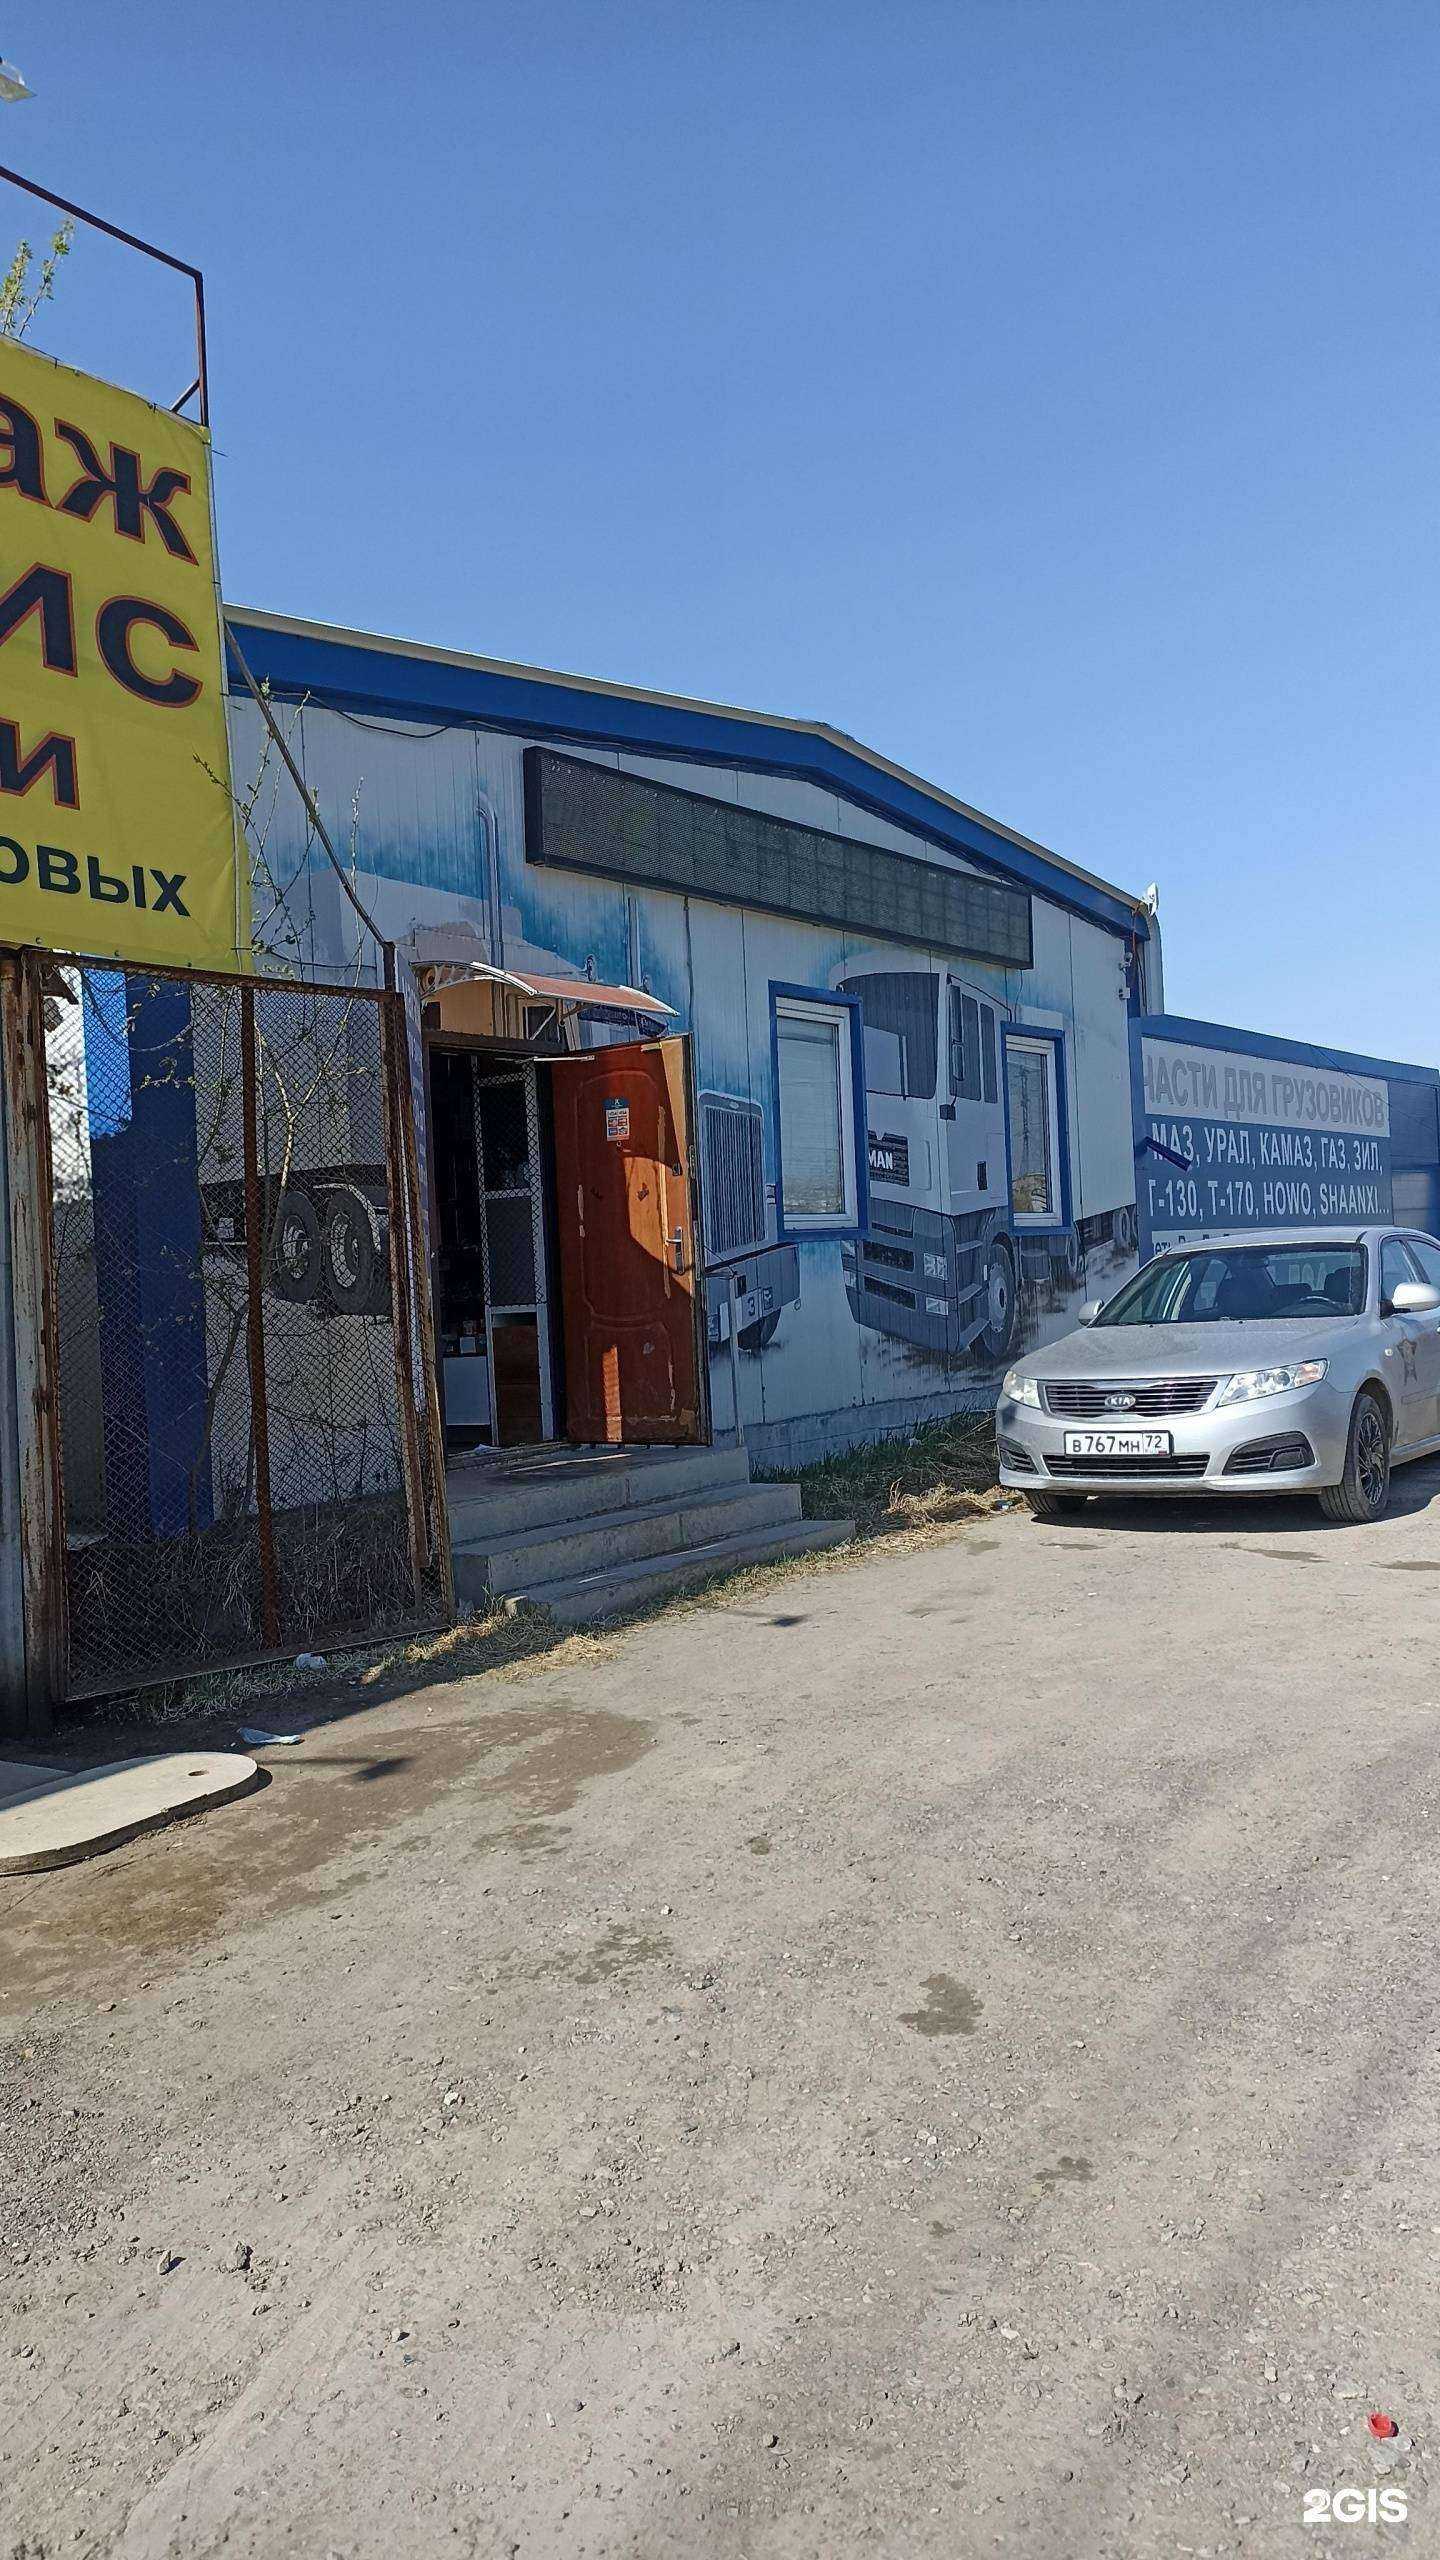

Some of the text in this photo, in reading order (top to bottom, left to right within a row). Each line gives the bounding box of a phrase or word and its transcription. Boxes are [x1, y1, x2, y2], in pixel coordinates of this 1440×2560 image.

[1224, 1067, 1267, 1121] ДЛЯ
[1271, 1074, 1385, 1128] ГРУЗОВИКОВ
[1204, 1127, 1256, 1170] УРАЛ,
[1259, 1132, 1318, 1173] КАМАЗ,
[1321, 1137, 1351, 1174] ГАЗ,
[1353, 1140, 1383, 1176] ЗИЛ,
[1208, 1181, 1258, 1220] Т-170,
[1264, 1181, 1317, 1219] HOWO,
[1109, 1396, 1132, 1405] KIA
